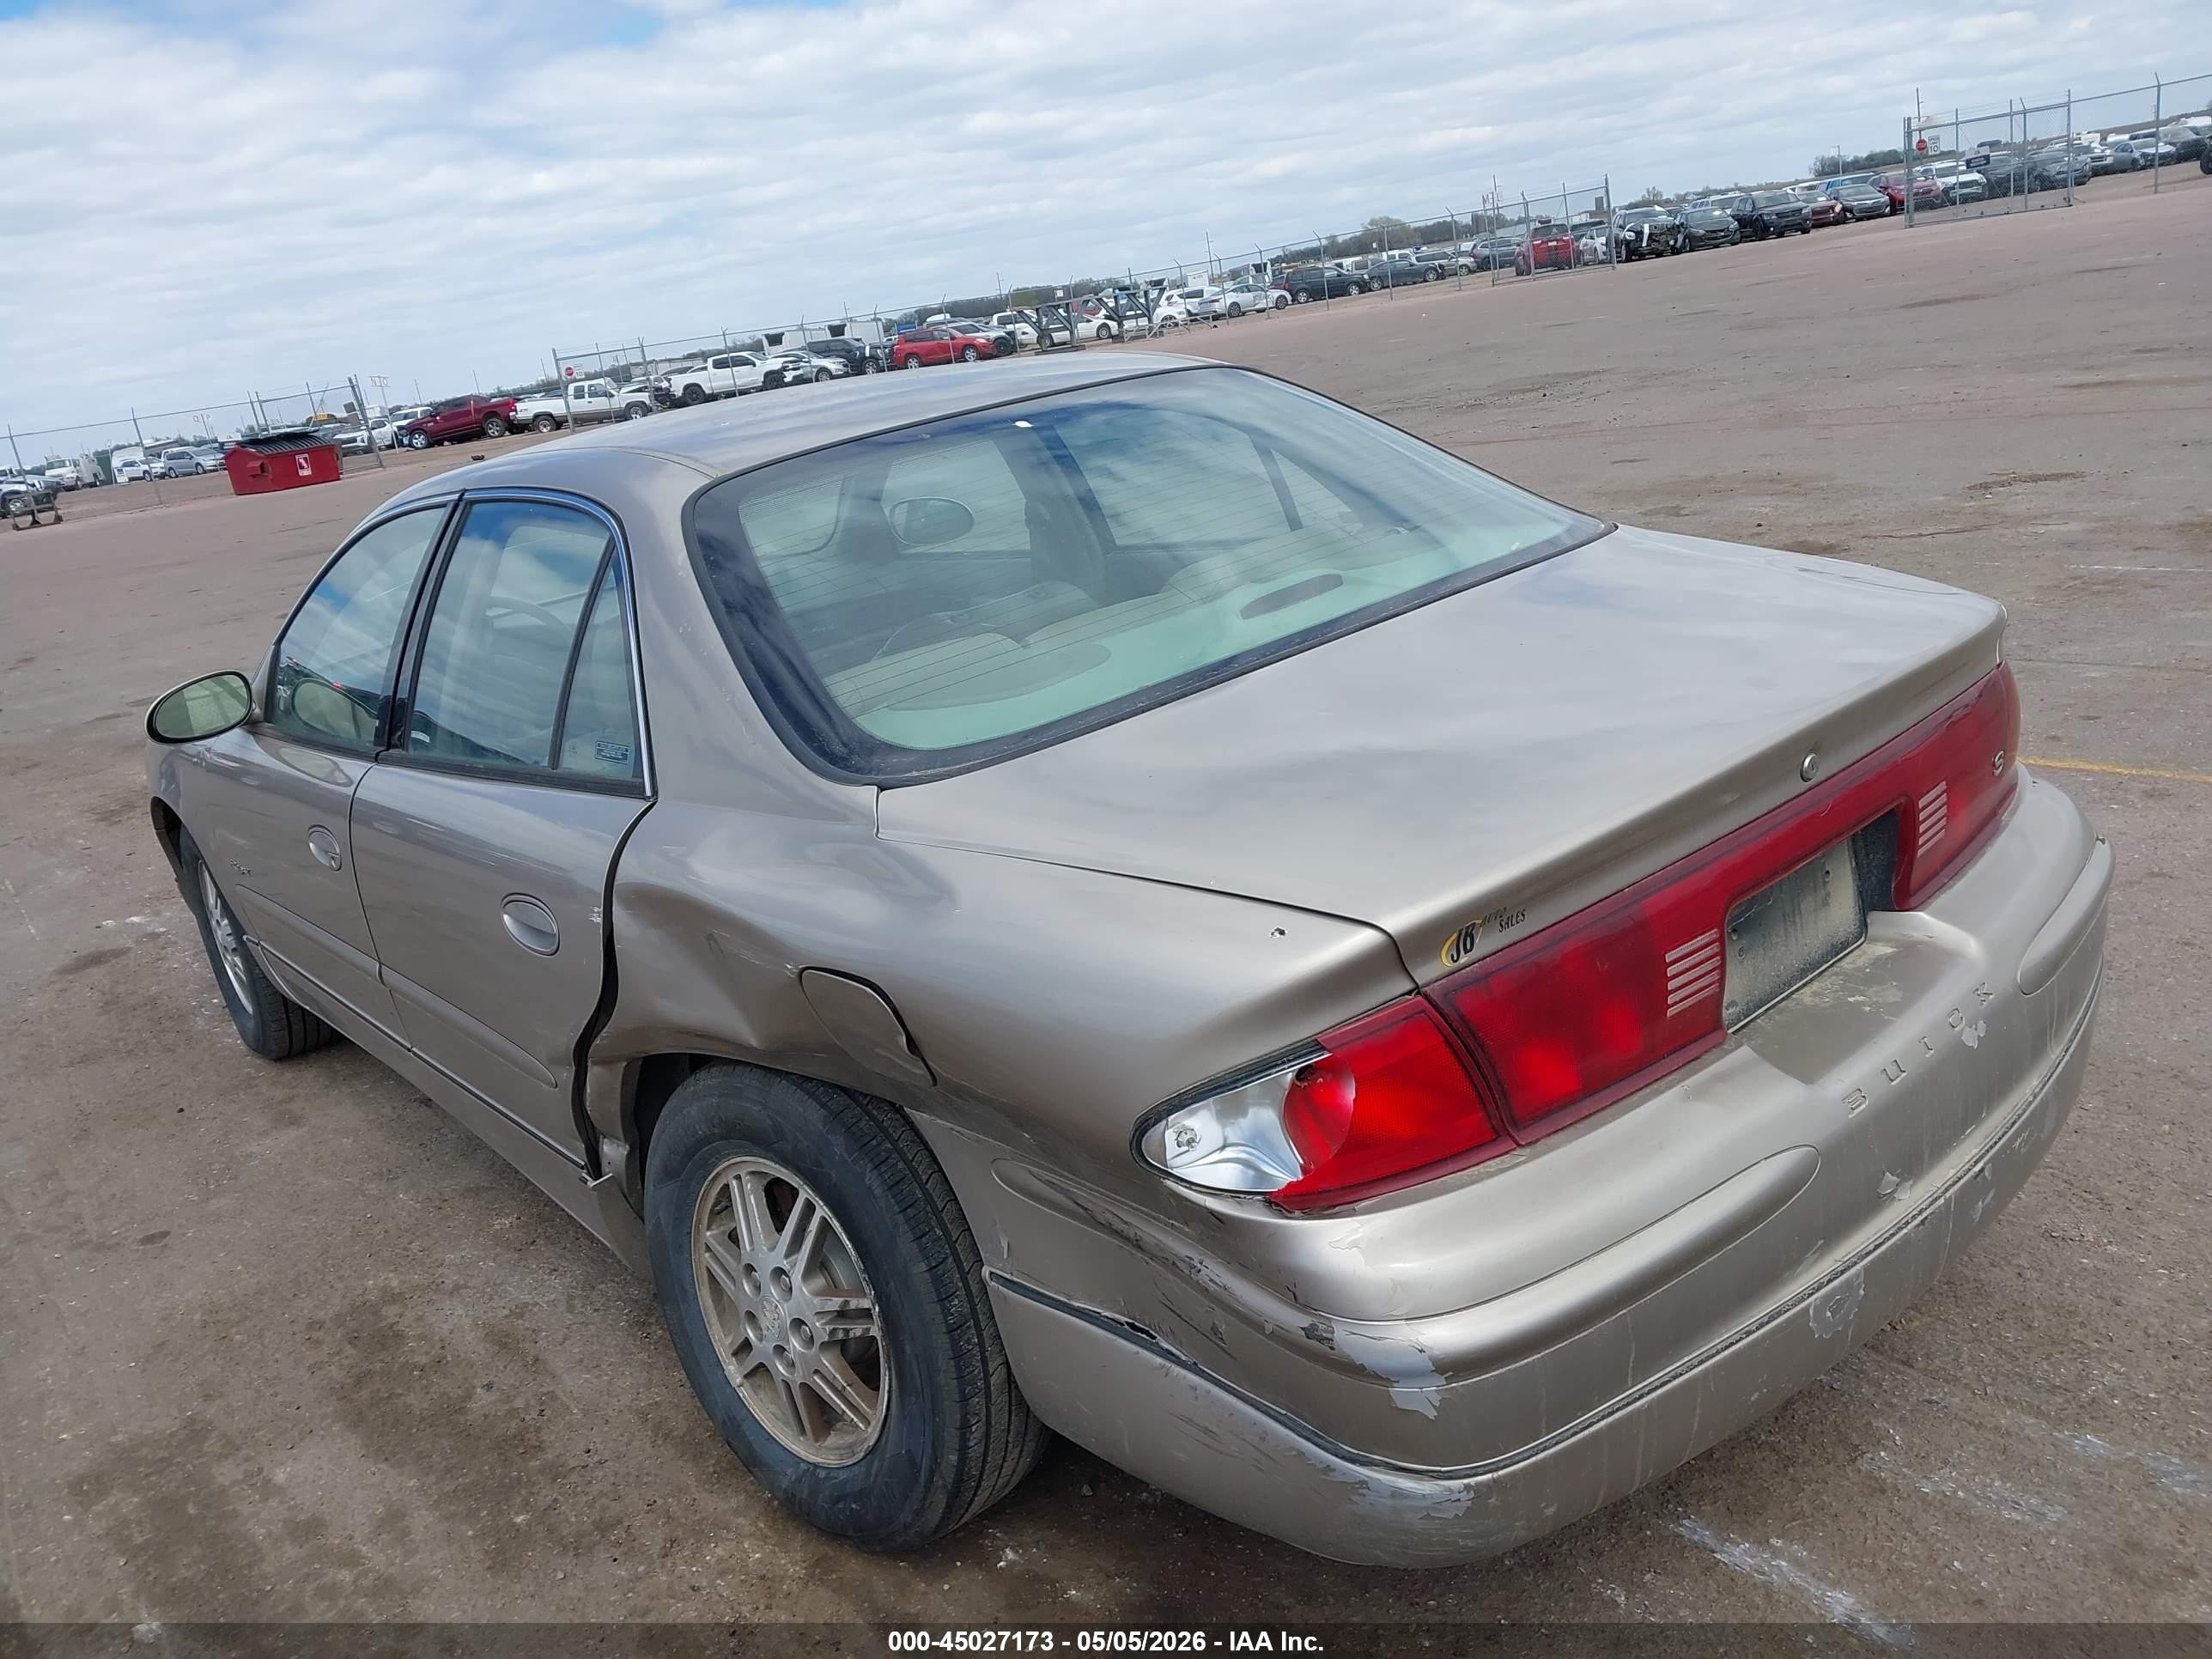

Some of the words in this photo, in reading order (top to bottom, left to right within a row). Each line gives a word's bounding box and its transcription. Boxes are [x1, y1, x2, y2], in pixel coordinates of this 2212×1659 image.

[1929, 144, 1939, 153] 10
[1498, 908, 1526, 933] SALES
[1449, 921, 1477, 963] JB
[1841, 981, 1994, 1119] BUICK
